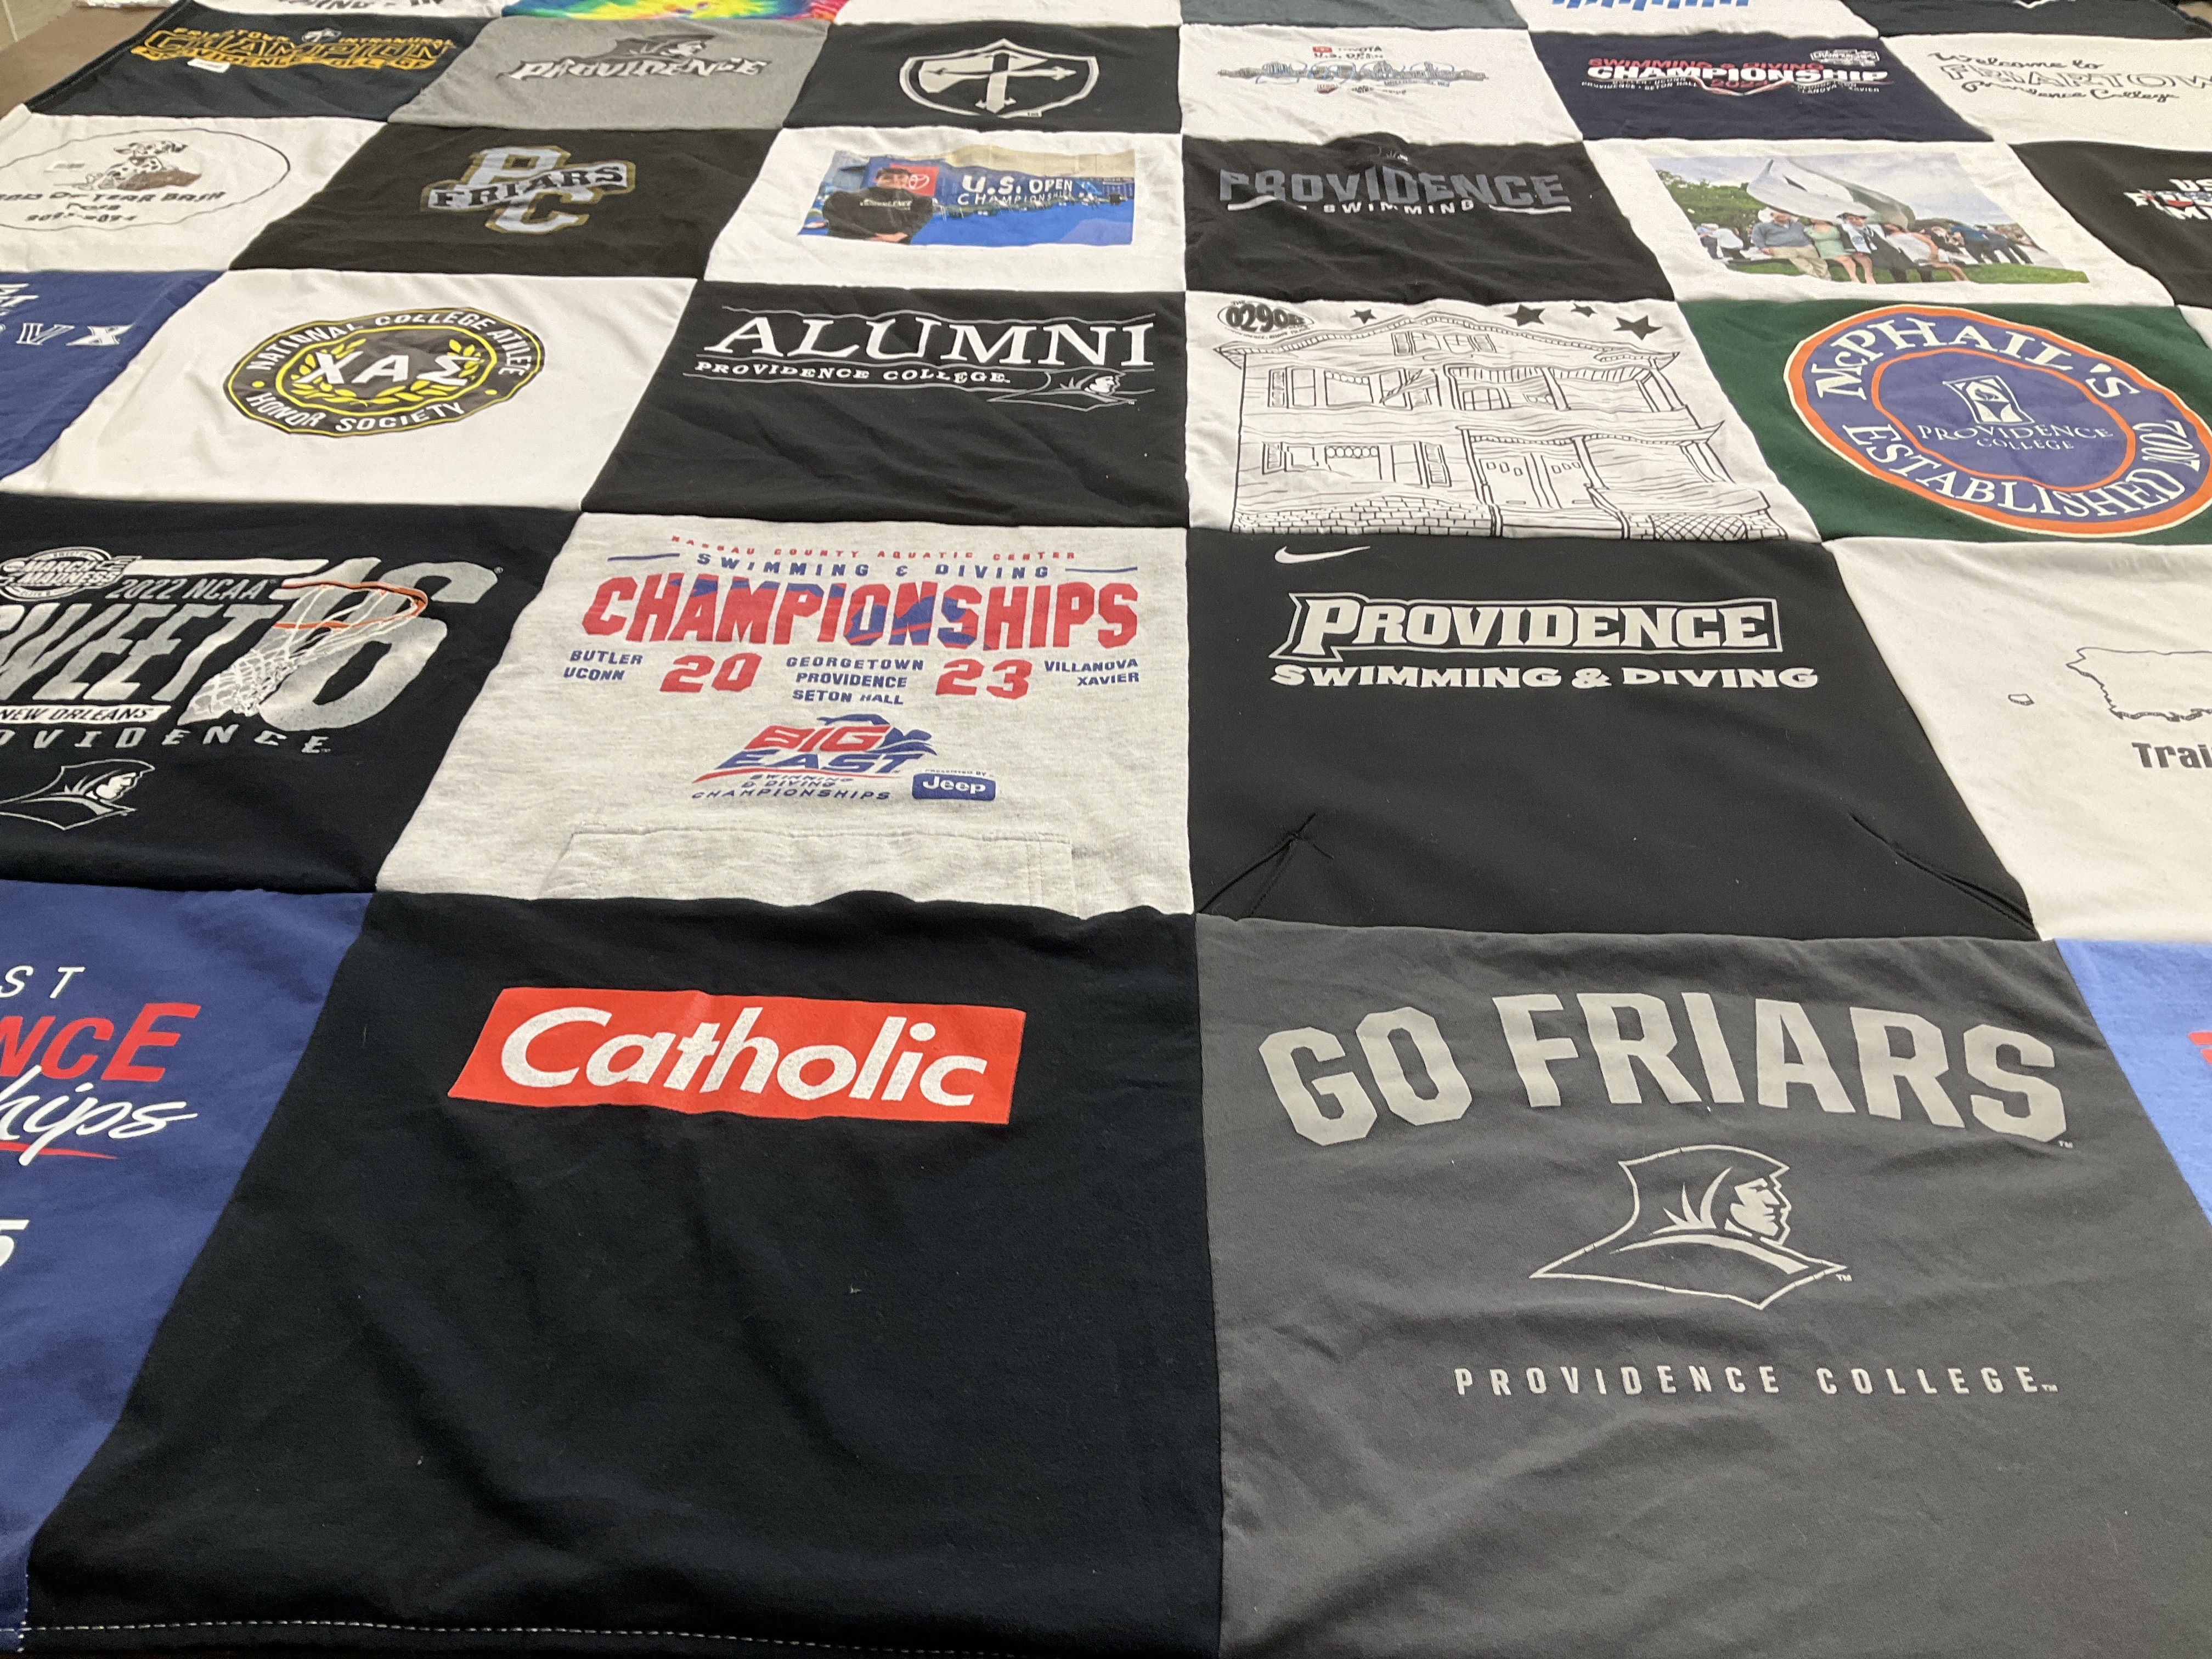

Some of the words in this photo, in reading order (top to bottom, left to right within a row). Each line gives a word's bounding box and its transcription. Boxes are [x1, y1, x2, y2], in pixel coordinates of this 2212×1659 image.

[504, 58, 769, 80] PROVIDENCE
[1928, 52, 2067, 68] Welcome
[2073, 59, 2104, 69] to
[1588, 66, 1888, 82] CHAMPIONSHIP
[436, 166, 624, 207] FRIARS
[962, 176, 1021, 195] U.S.
[1029, 178, 1073, 194] OPEN
[1220, 166, 1572, 205] PROVIDENCE
[246, 323, 363, 371] NATIONAL
[375, 312, 496, 330] COLLEGE
[487, 329, 533, 377] ATHLETE
[704, 317, 1154, 367] ALUMNI
[695, 361, 870, 379] PROVIDENCE
[246, 392, 326, 427] HONOR
[335, 401, 465, 432] SOCIETY
[1917, 424, 2114, 441] PROVIDENCE
[1976, 438, 2074, 450] COLLEGE
[1842, 423, 2186, 517] ESTABLISHED
[697, 552, 869, 577] SWIMMING
[934, 564, 1049, 579] DIVING
[774, 548, 860, 558] COUNTY
[877, 550, 973, 560] AQUATIC
[993, 551, 1075, 561] CENTER
[105, 578, 188, 600] 2022
[582, 572, 1138, 651] CHAMPIONSHIPS
[1292, 597, 1770, 655] PROVIDENCE
[0, 603, 284, 701] WEET
[569, 650, 643, 665] BUTLER
[786, 656, 924, 670] GEORGETOWN
[563, 667, 626, 681] UCONN
[659, 652, 763, 693] 20
[935, 658, 1033, 699] 23
[1044, 658, 1138, 673] VILLANOVA
[1270, 664, 1562, 689] SWIMMING
[1571, 665, 1612, 689] &
[1622, 665, 1819, 689] DIVING
[795, 672, 907, 689] PROVIDENCE
[1077, 672, 1139, 687] XAVIER
[792, 690, 853, 702] SETON
[860, 693, 904, 705] HALL
[1, 708, 49, 720] NEW
[48, 707, 154, 721] ORLEANS
[743, 724, 891, 752] BIG
[715, 748, 924, 774] EAST
[2131, 742, 2212, 769] Trai
[691, 789, 891, 800] CHAMPIONSHIPS
[922, 775, 986, 795] Jeep
[501, 1006, 988, 1107] Catholic
[1259, 1005, 1472, 1147] GO
[1492, 991, 2068, 1143] FRIARS
[1454, 1365, 1780, 1396] PROVIDENCE
[1816, 1365, 2041, 1396] COLLEGE
